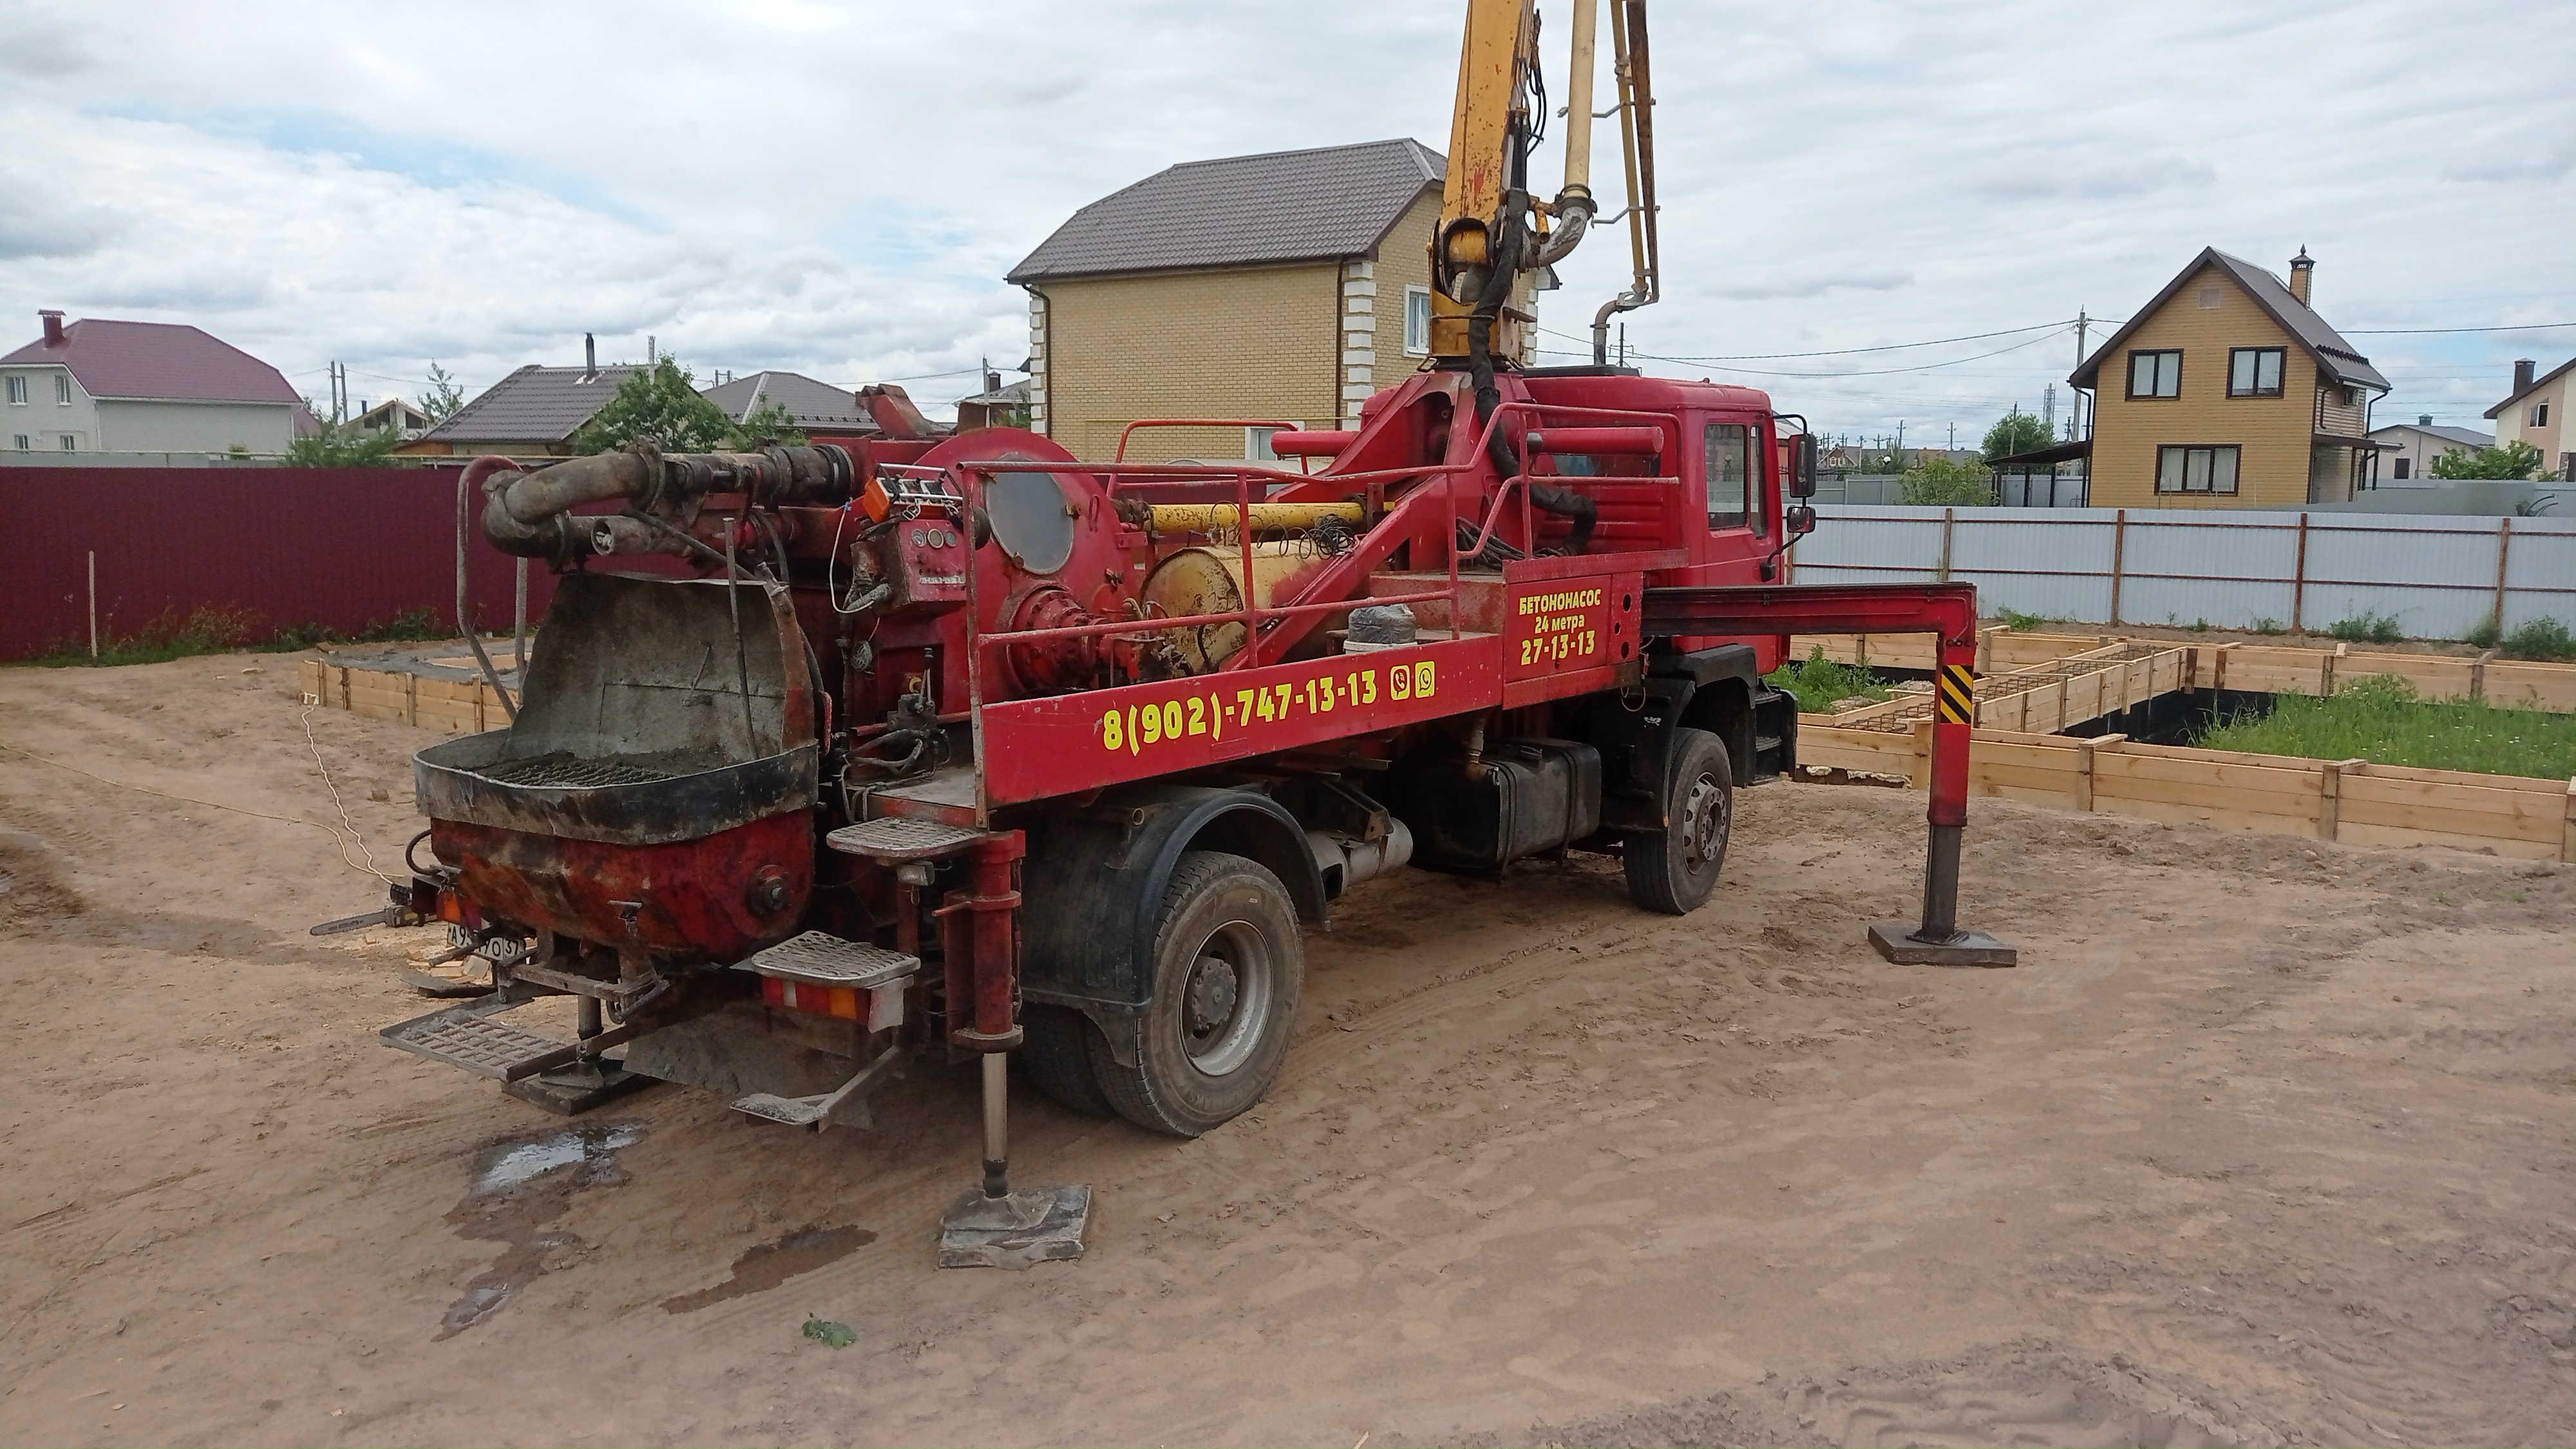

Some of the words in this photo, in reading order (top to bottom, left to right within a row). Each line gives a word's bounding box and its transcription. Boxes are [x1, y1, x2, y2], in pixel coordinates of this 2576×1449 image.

[1519, 589, 1602, 616] БЕТОНОНАСОС
[1535, 615, 1549, 634] 24
[1551, 614, 1585, 634] метра
[1520, 630, 1595, 666] 27-13-13
[1103, 669, 1377, 757] 8(902)-747-13-13
